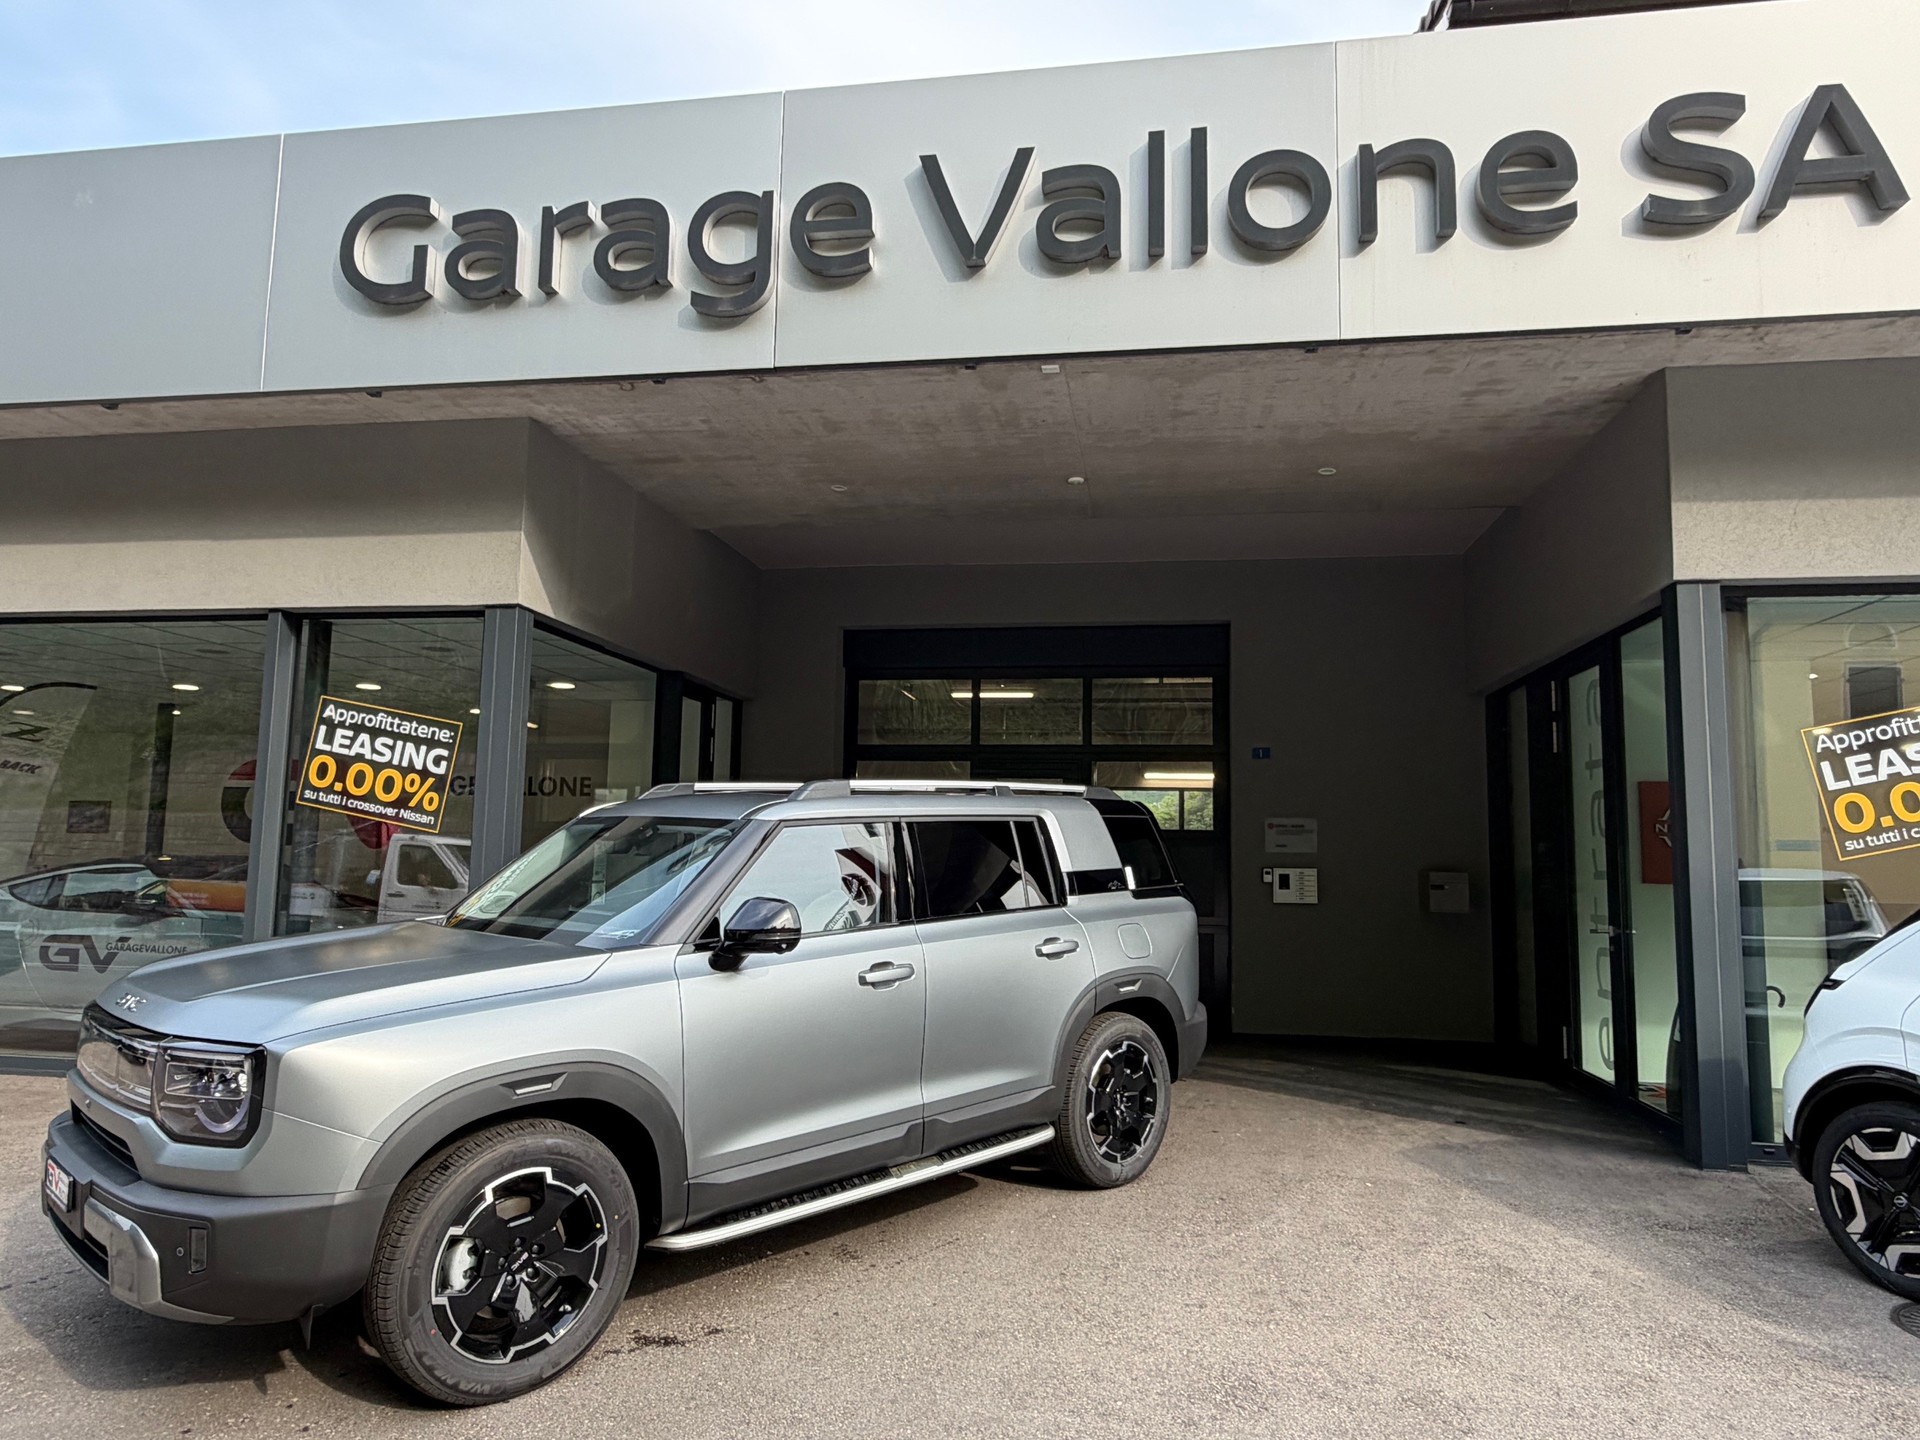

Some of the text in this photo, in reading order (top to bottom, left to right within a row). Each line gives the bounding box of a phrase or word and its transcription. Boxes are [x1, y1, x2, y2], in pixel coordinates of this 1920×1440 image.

[339, 83, 1912, 319] Garage Vallone SA
[322, 704, 455, 743] Approfittatene:
[1816, 715, 1920, 754] Approfit
[315, 725, 450, 775] LEASING
[308, 754, 440, 812] 0.00%
[304, 789, 318, 800] su
[318, 791, 342, 806] tutti
[347, 799, 399, 818] crossover
[399, 807, 435, 825] Nissan
[1845, 838, 1865, 851] su
[1865, 829, 1901, 847] tutti
[1902, 828, 1908, 840] i
